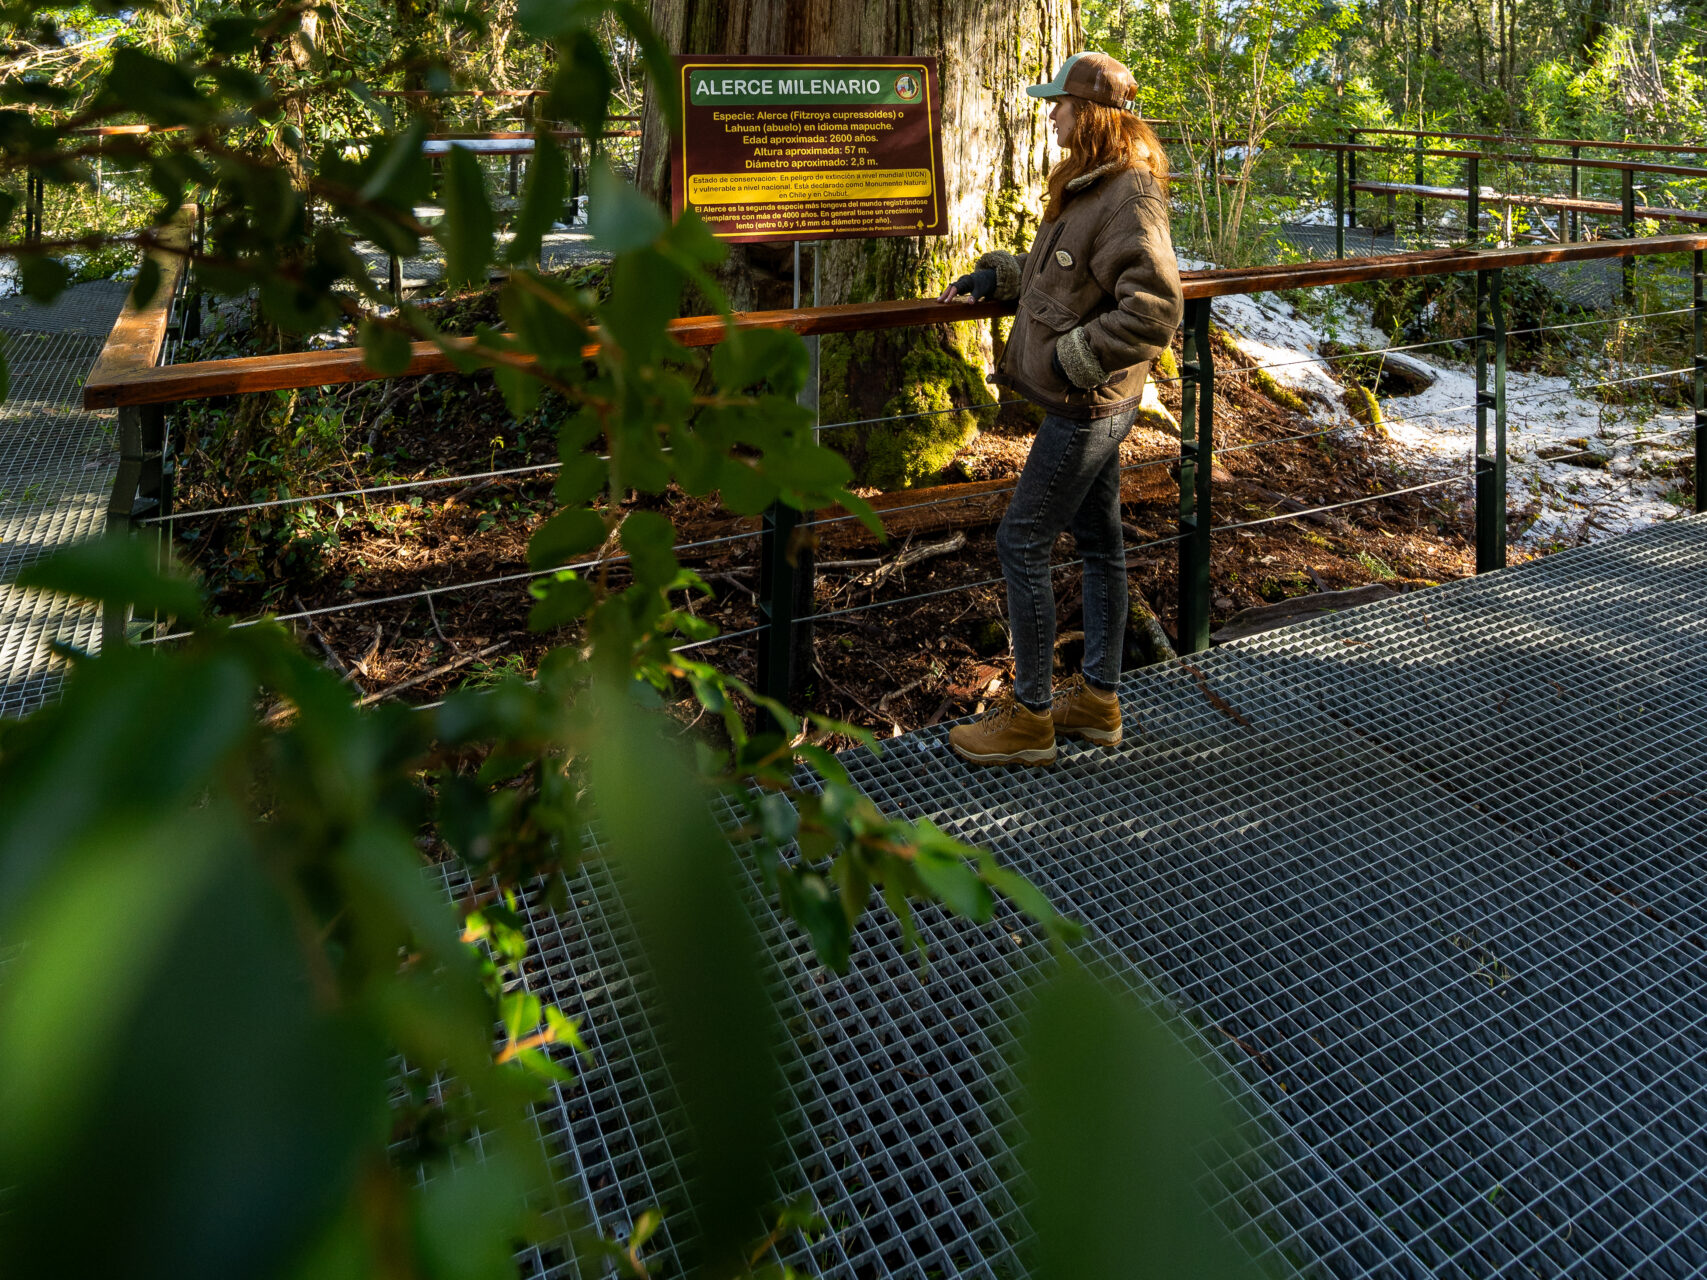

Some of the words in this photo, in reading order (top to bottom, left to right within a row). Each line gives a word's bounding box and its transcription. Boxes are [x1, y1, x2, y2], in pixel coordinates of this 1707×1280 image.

[696, 80, 773, 95] ALERCE
[779, 79, 880, 95] MILENARIO
[713, 112, 755, 122] Especie:
[757, 111, 788, 120] Alerce
[790, 111, 830, 121] (Fitzroya
[832, 110, 896, 120] cupressoides)
[725, 124, 761, 132] Lahuan
[763, 123, 802, 133] (abuelo)
[817, 122, 848, 131] idioma
[850, 122, 894, 131] mapuche.
[743, 135, 768, 144] Edad
[770, 135, 828, 145] aproximada:
[830, 134, 852, 143] 2600
[854, 134, 878, 142] años.
[754, 148, 783, 156] Altura
[785, 147, 842, 157] aproximada:
[844, 146, 856, 154] 57
[745, 160, 789, 169] Diámetro
[791, 159, 848, 169] aproximado:
[851, 158, 865, 167] 2,8
[790, 174, 814, 182] peligro
[746, 204, 775, 212] segunda
[777, 203, 803, 211] especie
[821, 202, 847, 210] longeva
[883, 199, 928, 207] registrándose
[701, 215, 740, 223] ejemplares
[831, 210, 856, 218] general
[796, 220, 806, 228] 1,6
